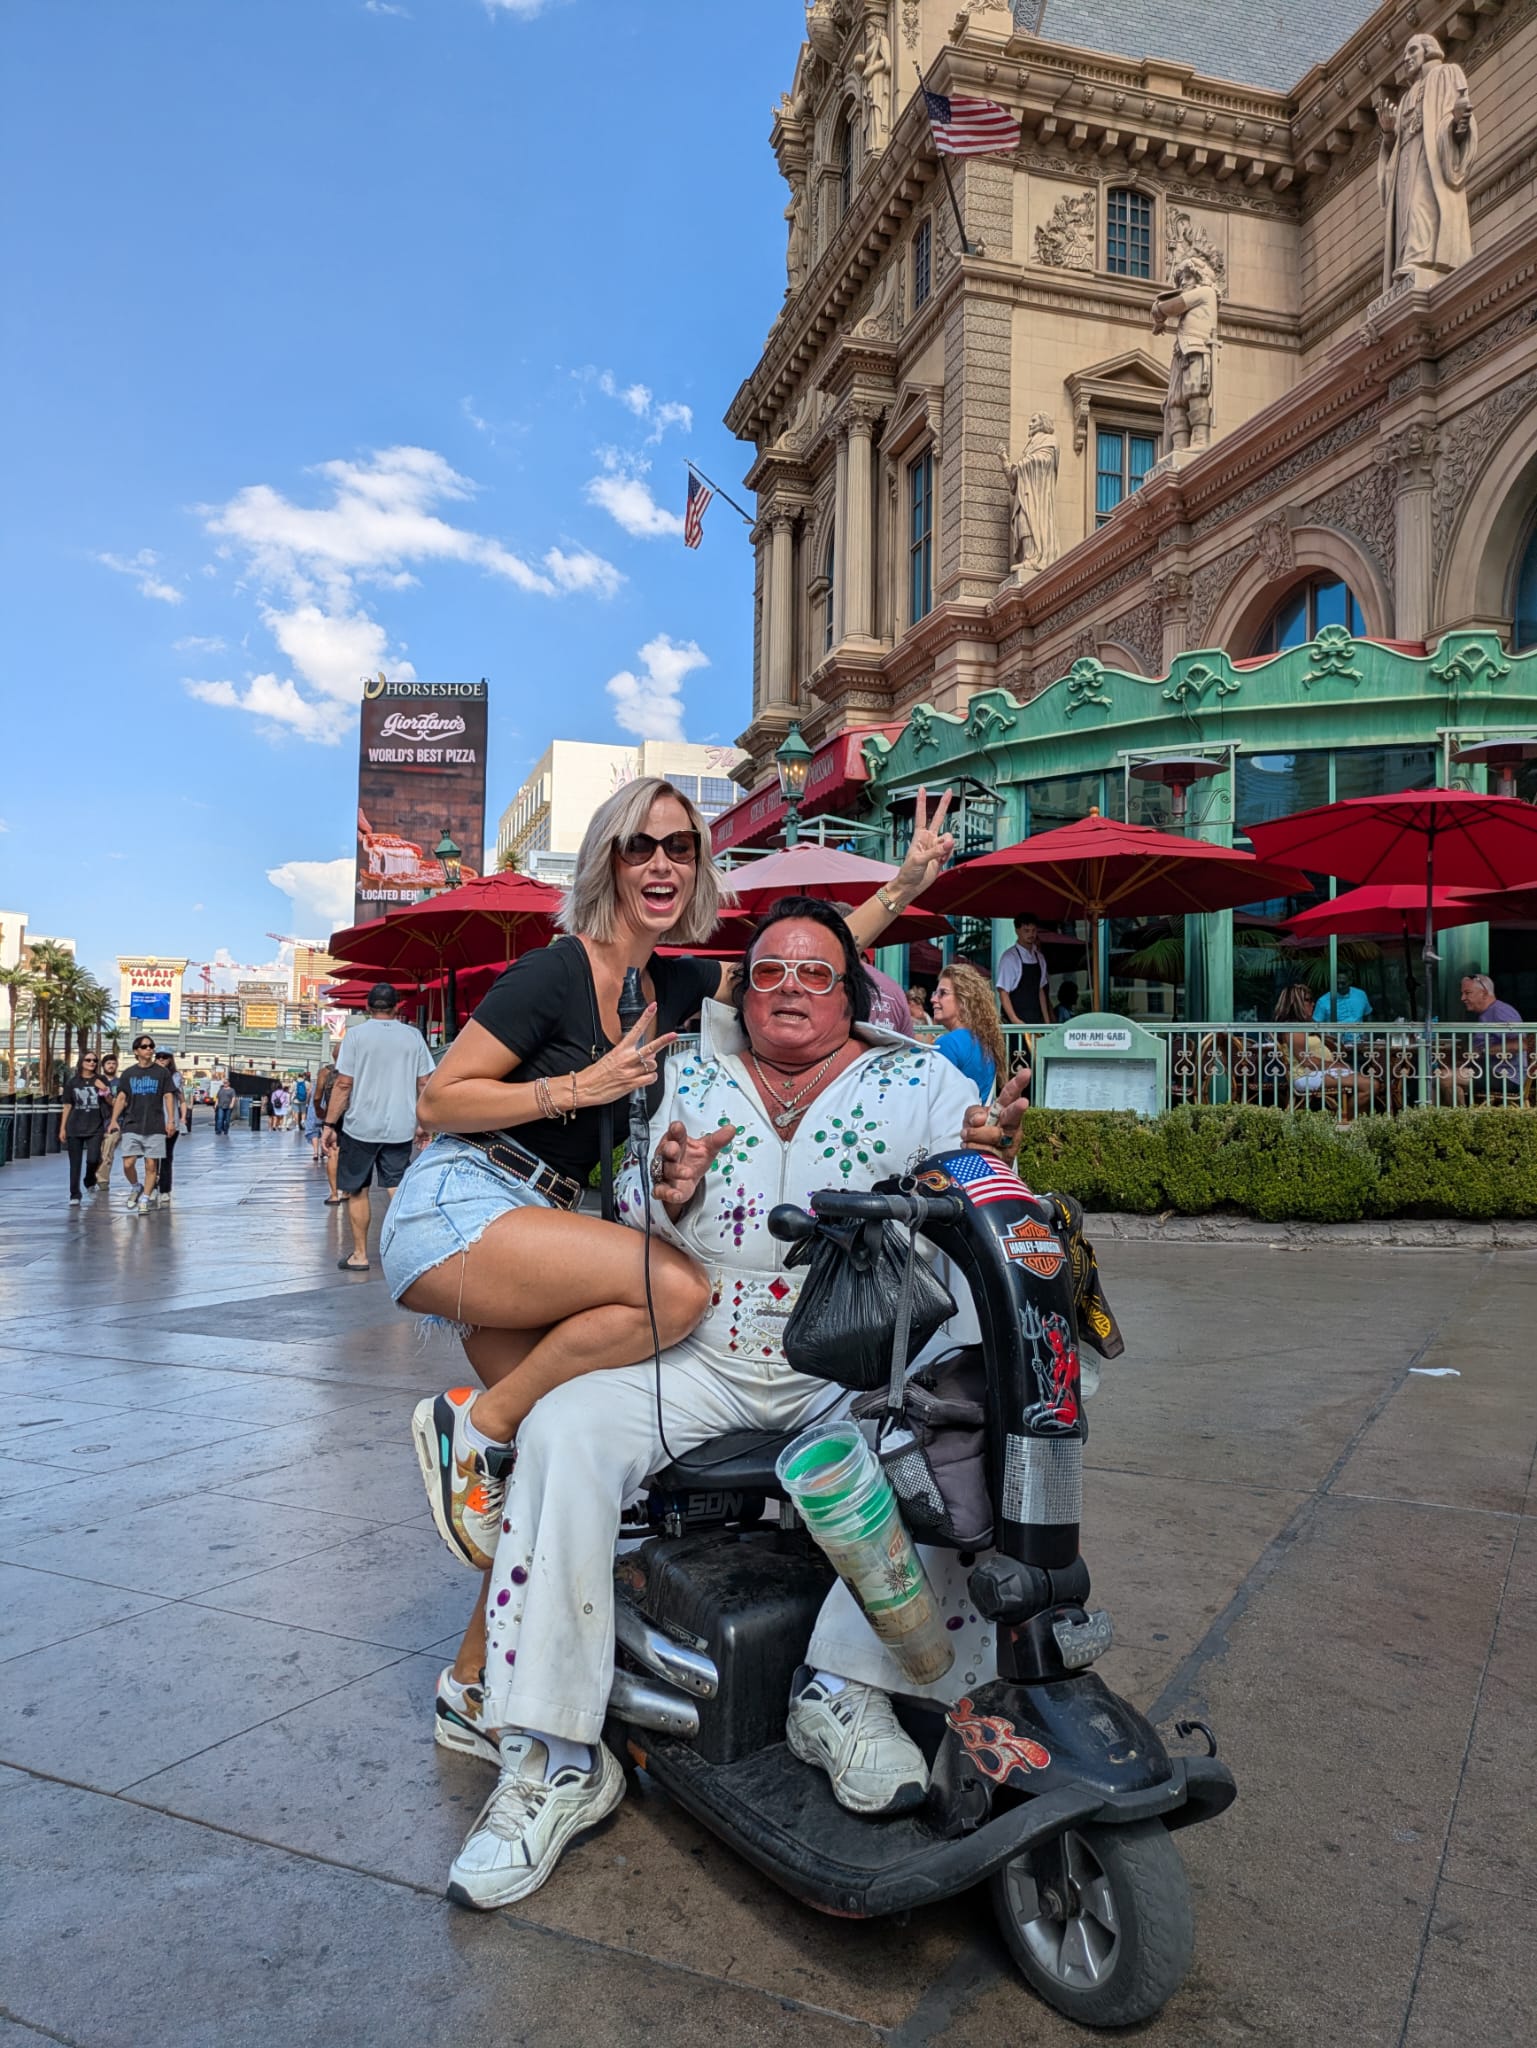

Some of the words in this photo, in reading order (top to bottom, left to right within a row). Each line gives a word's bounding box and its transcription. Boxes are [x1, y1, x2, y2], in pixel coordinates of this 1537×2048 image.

[386, 683, 481, 697] HORSESHOE
[380, 712, 466, 741] Giordano's
[368, 748, 414, 762] WORLD'S
[417, 748, 443, 762] BEST
[446, 749, 476, 763] PIZZA
[361, 889, 398, 901] LOCATED
[400, 889, 420, 901] BEH
[129, 969, 175, 978] CAESARS
[131, 978, 173, 987] PALACE
[1018, 1223, 1047, 1238] MOTOR
